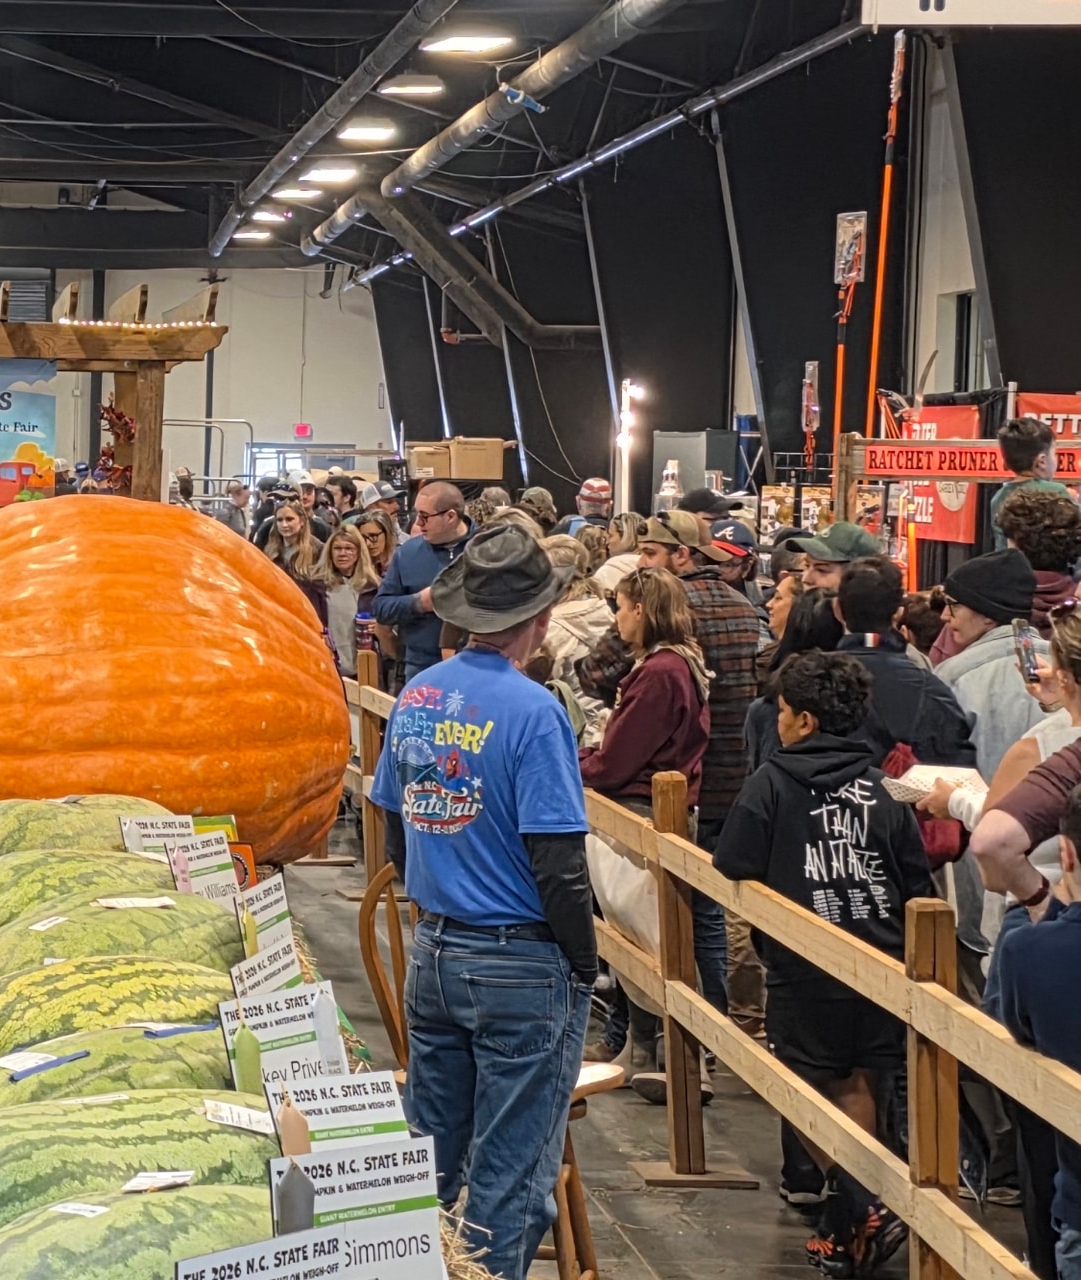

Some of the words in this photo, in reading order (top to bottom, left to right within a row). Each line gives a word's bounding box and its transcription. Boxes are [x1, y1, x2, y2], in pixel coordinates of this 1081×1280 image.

[13, 421, 38, 433] Fair
[868, 450, 934, 470] RATCHET
[938, 451, 998, 471] PRUNER
[809, 804, 868, 848] THAN
[204, 883, 237, 899] Williams
[224, 1010, 240, 1023] THE
[243, 1007, 264, 1018] 2026
[266, 1002, 283, 1014] N.C.
[285, 997, 309, 1010] STATE
[293, 1089, 318, 1102] 2026
[321, 1087, 339, 1099] N.C.
[341, 1084, 369, 1098] STATE
[371, 1081, 393, 1095] FAIR
[330, 1104, 367, 1115] WATERMELON
[368, 1100, 396, 1109] WEIGH-OFF
[337, 1160, 360, 1174] N.C.
[364, 1153, 398, 1171] STATE
[402, 1149, 429, 1165] FAIR
[345, 1178, 392, 1192] WATERMELON
[393, 1171, 430, 1185] WEIGH-OFF
[319, 1213, 337, 1223] GIANT
[338, 1207, 377, 1221] WATERMELON
[378, 1204, 396, 1214] ENTRY
[246, 1256, 269, 1275] N.C.
[273, 1246, 309, 1268] STATE
[312, 1238, 339, 1259] FAIR
[302, 1263, 339, 1280] WEIGH-OFF
